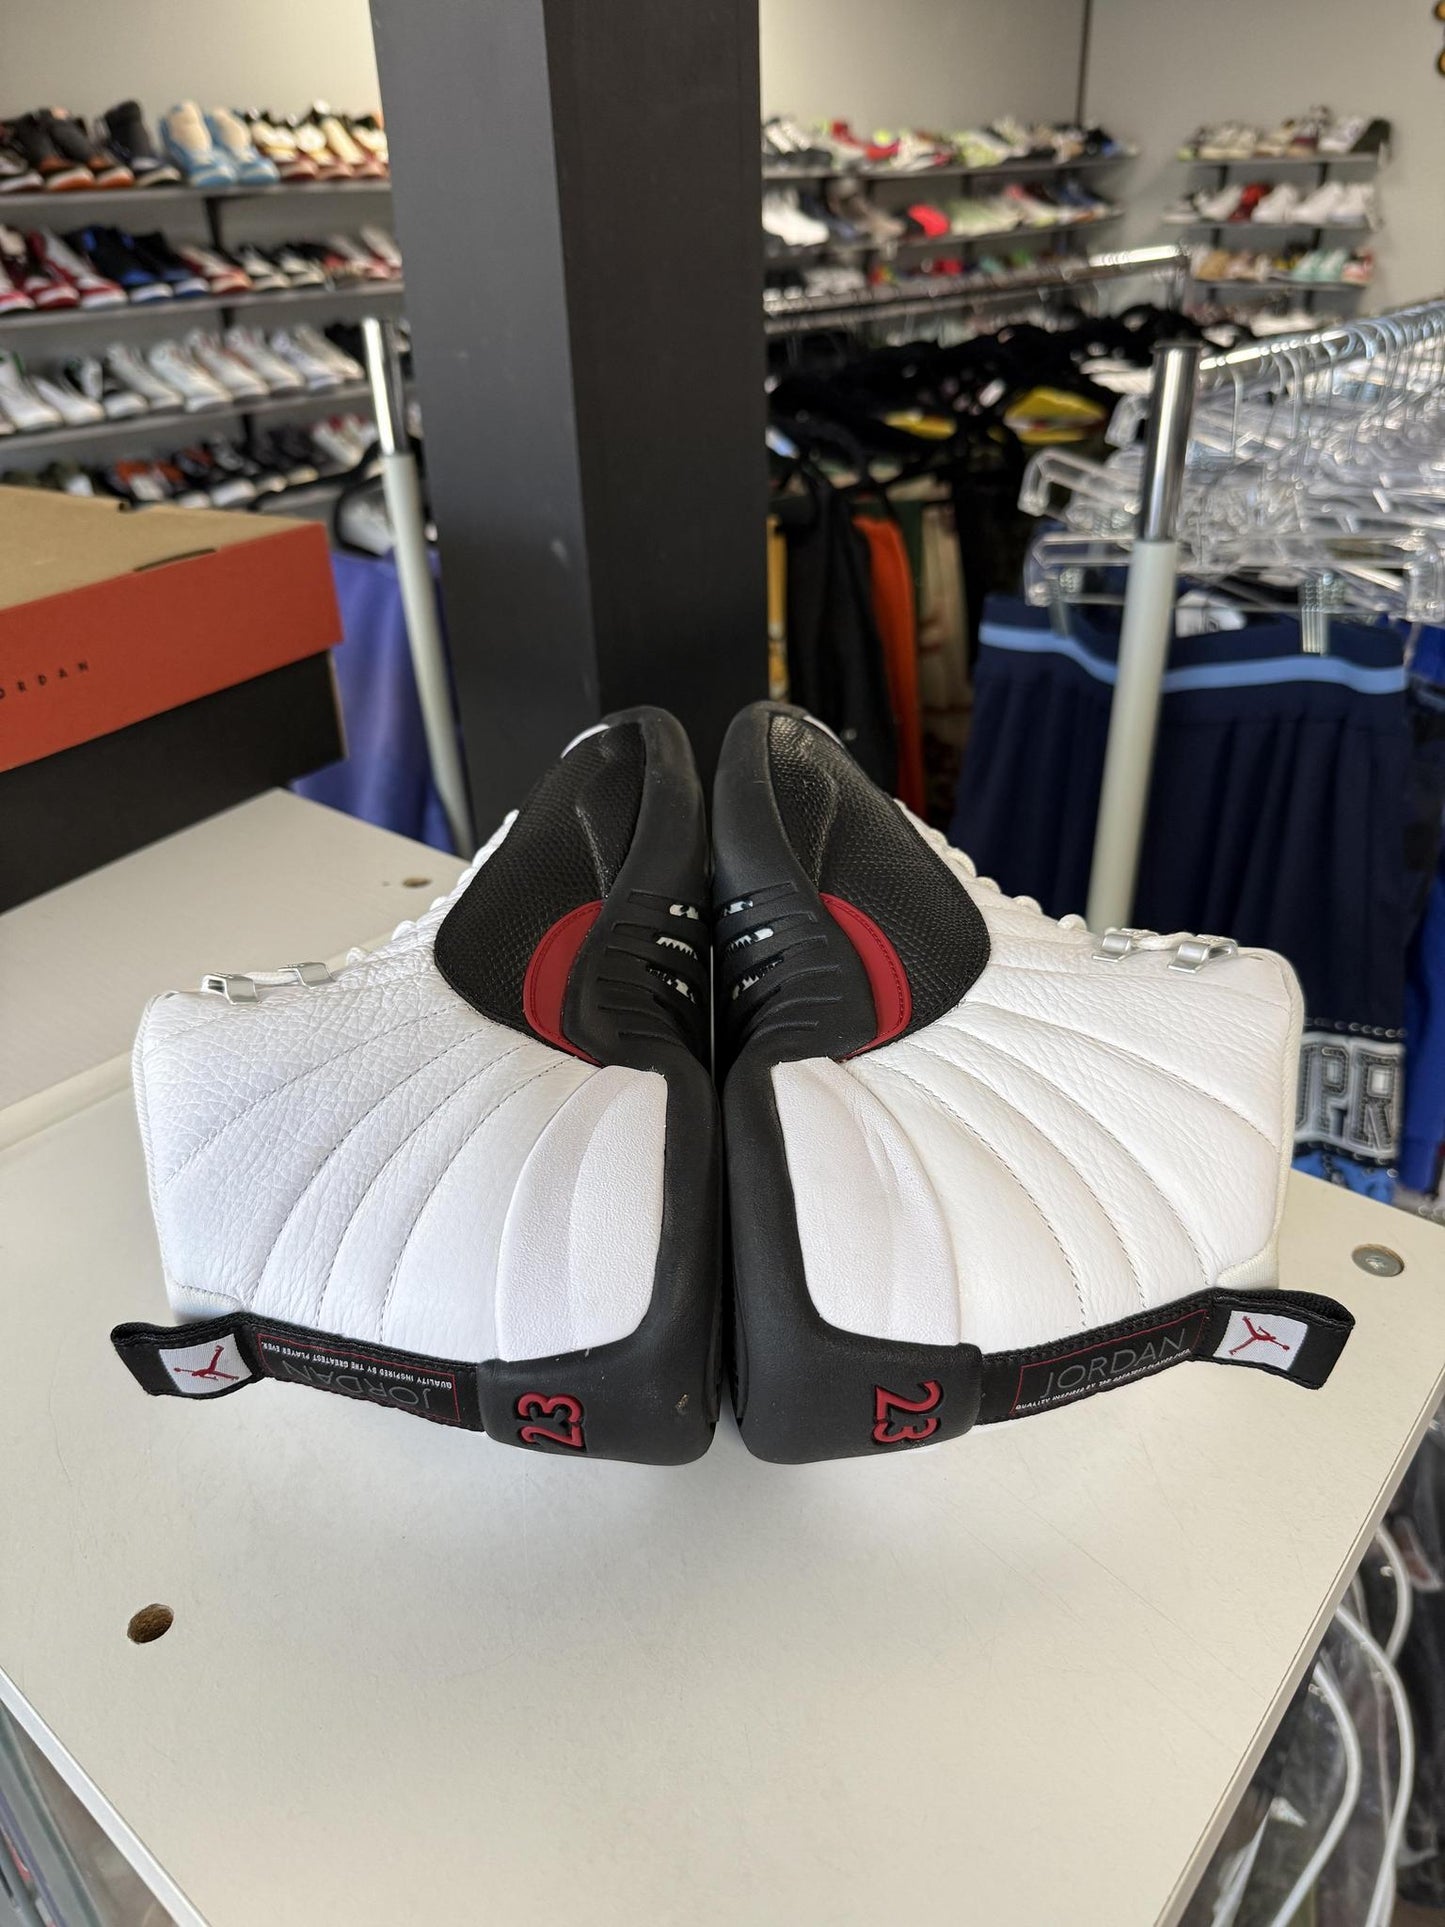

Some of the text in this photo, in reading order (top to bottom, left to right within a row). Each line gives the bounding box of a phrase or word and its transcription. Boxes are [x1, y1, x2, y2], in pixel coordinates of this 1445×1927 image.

[283, 1347, 310, 1360] PLAYER
[313, 1353, 349, 1369] GREATEST
[351, 1361, 365, 1372] THE
[1040, 1328, 1185, 1398] JORDAN
[367, 1365, 378, 1376] BY
[379, 1368, 414, 1382] INSPIRED
[282, 1362, 431, 1408] JORDAN
[417, 1376, 453, 1390] QUALITY
[1016, 1398, 1050, 1410] QUALITY
[874, 1380, 942, 1443] 23
[518, 1392, 584, 1448] 23
